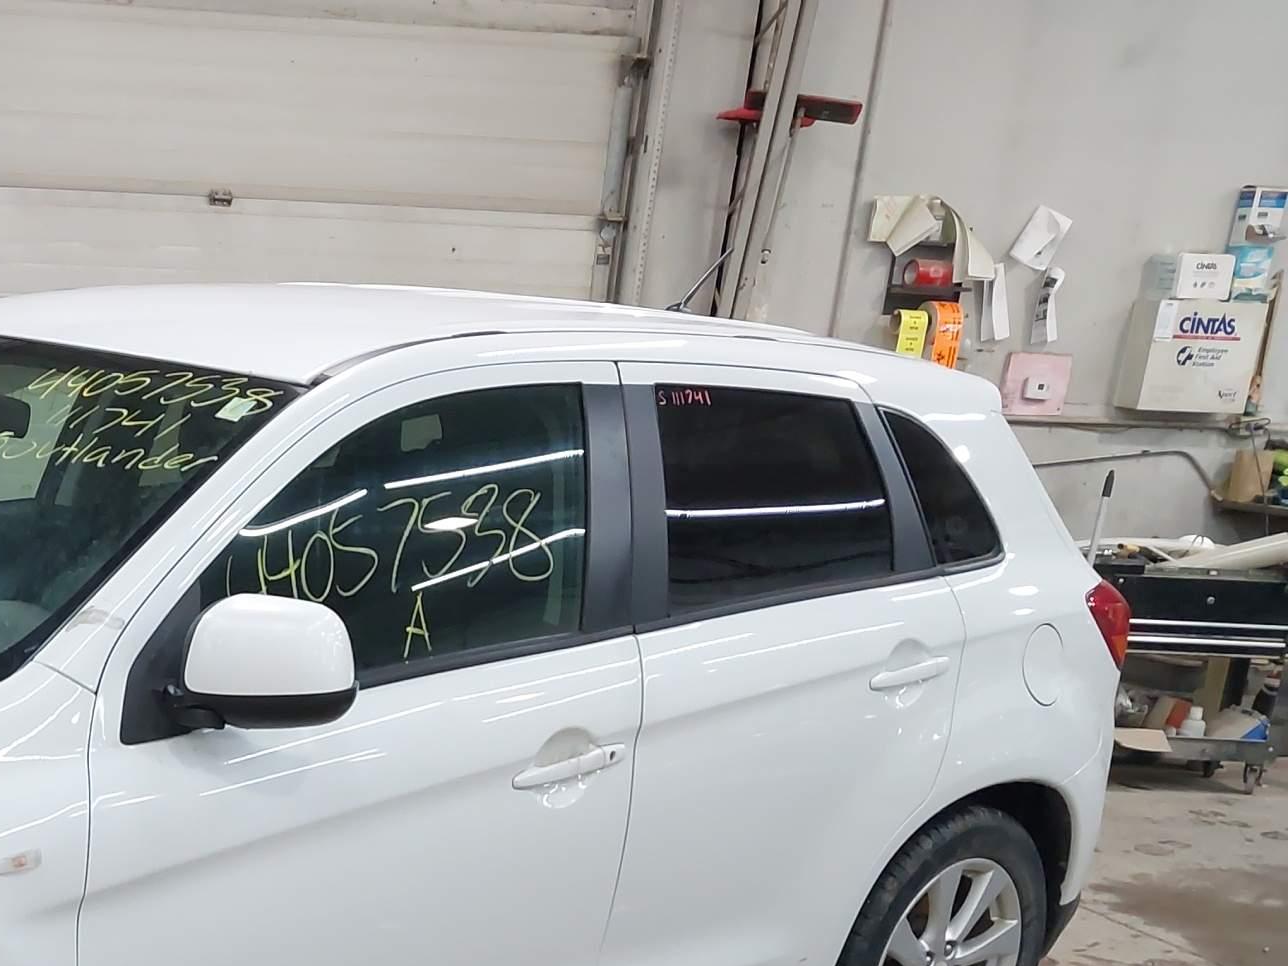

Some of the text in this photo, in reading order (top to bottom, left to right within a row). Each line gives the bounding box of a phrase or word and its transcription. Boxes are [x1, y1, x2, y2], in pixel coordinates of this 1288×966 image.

[1179, 311, 1236, 336] CINTAS
[27, 366, 284, 416] 44057538
[404, 591, 433, 659] A
